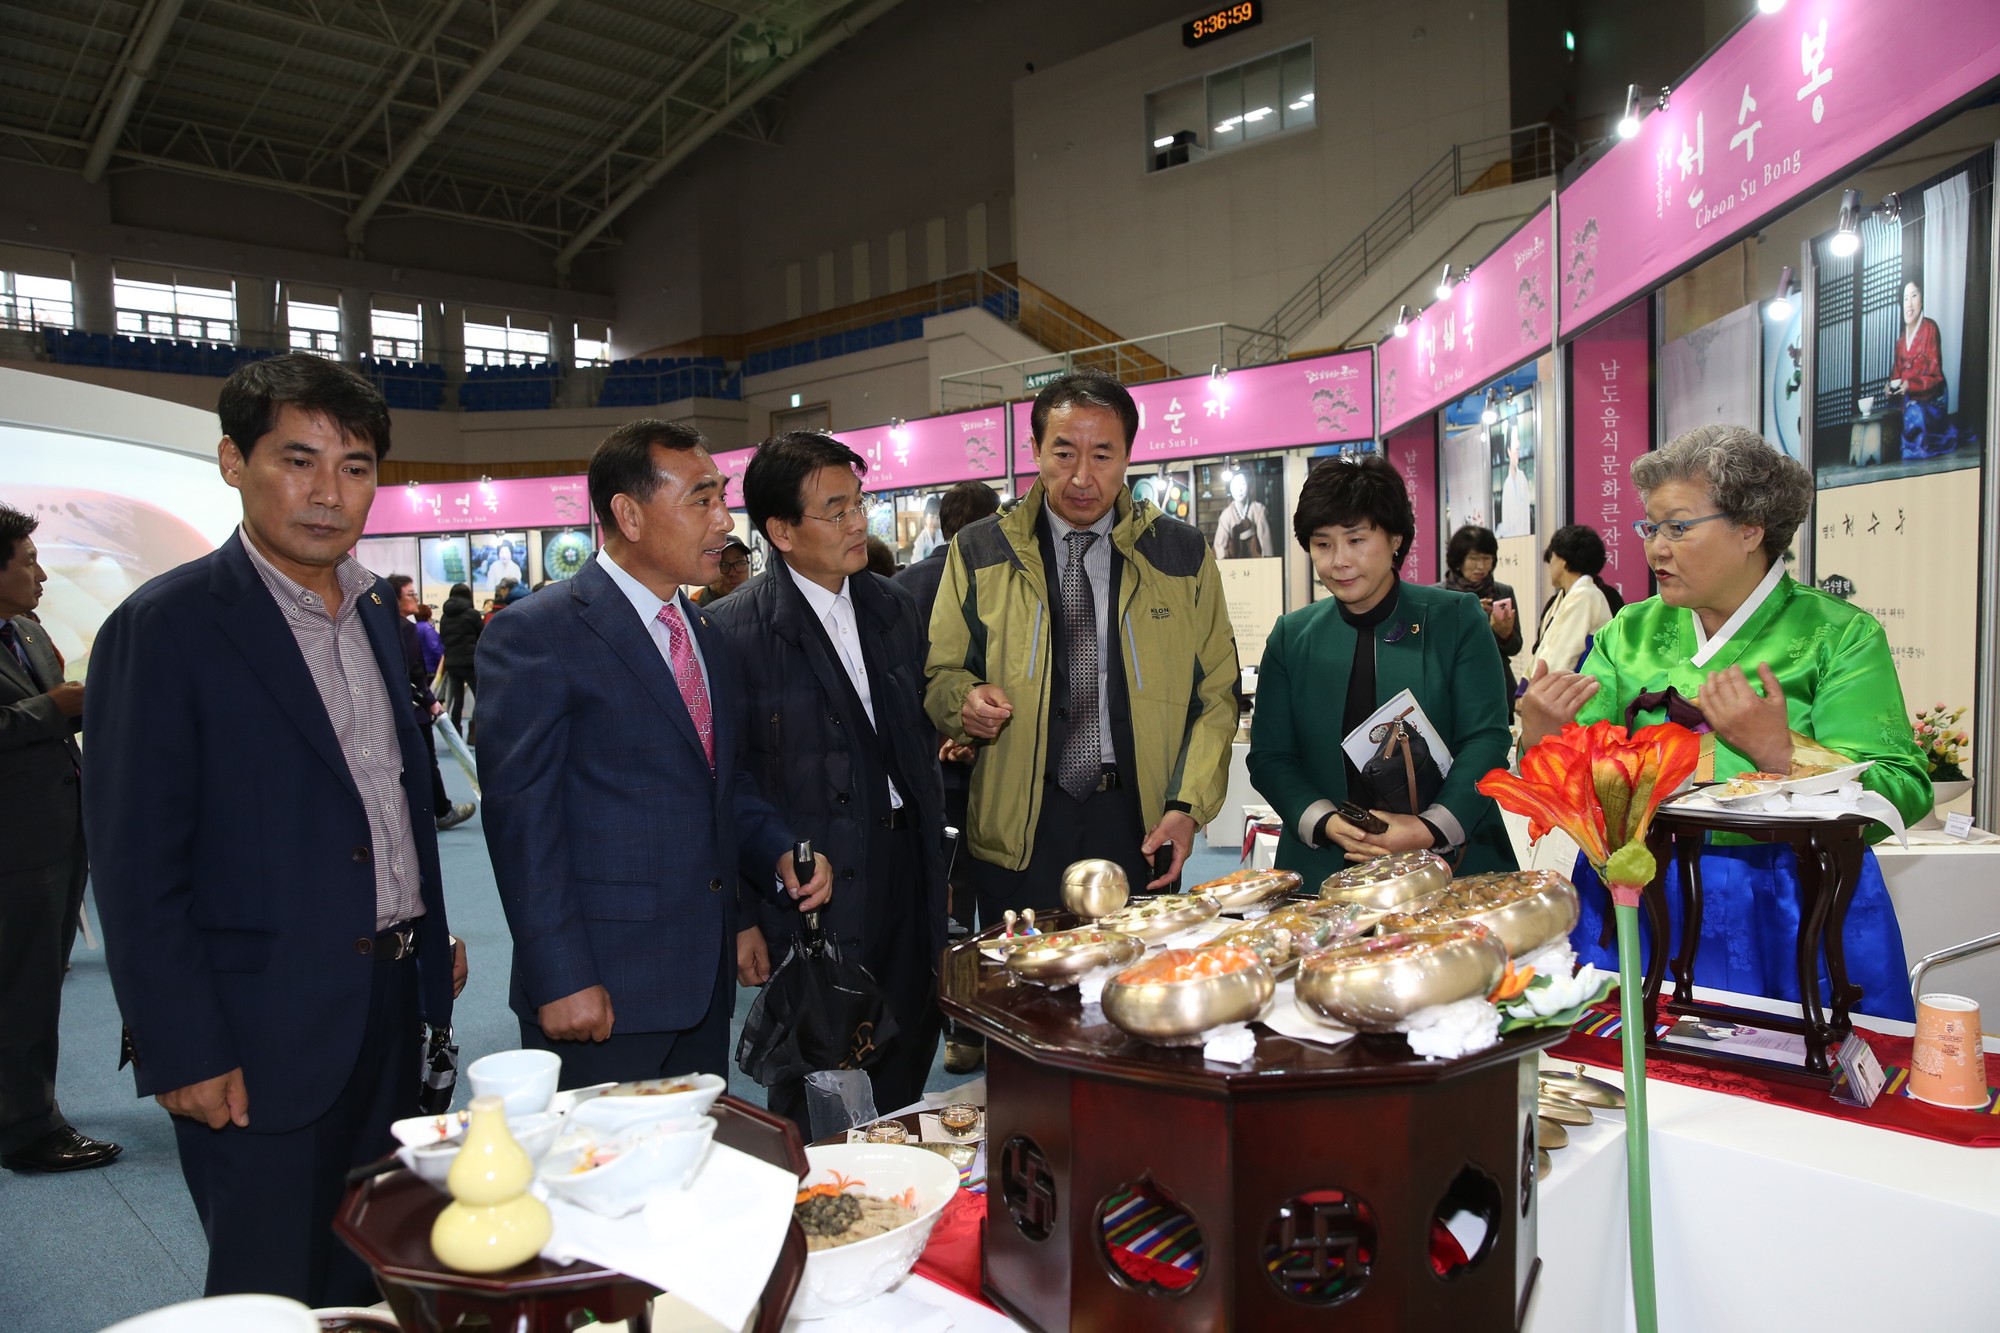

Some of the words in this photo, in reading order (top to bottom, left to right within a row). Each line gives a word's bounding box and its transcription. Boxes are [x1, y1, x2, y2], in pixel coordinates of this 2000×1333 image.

[1193, 2, 1253, 39] 3:36:59
[1696, 194, 1735, 229] Cheon
[1741, 178, 1757, 201] Su
[1764, 149, 1801, 187] Bong
[1150, 440, 1165, 450] Lee
[1169, 438, 1186, 449] Sun
[1189, 437, 1199, 447] Ja
[1599, 359, 1621, 571] 남도음식문화큰잔치
